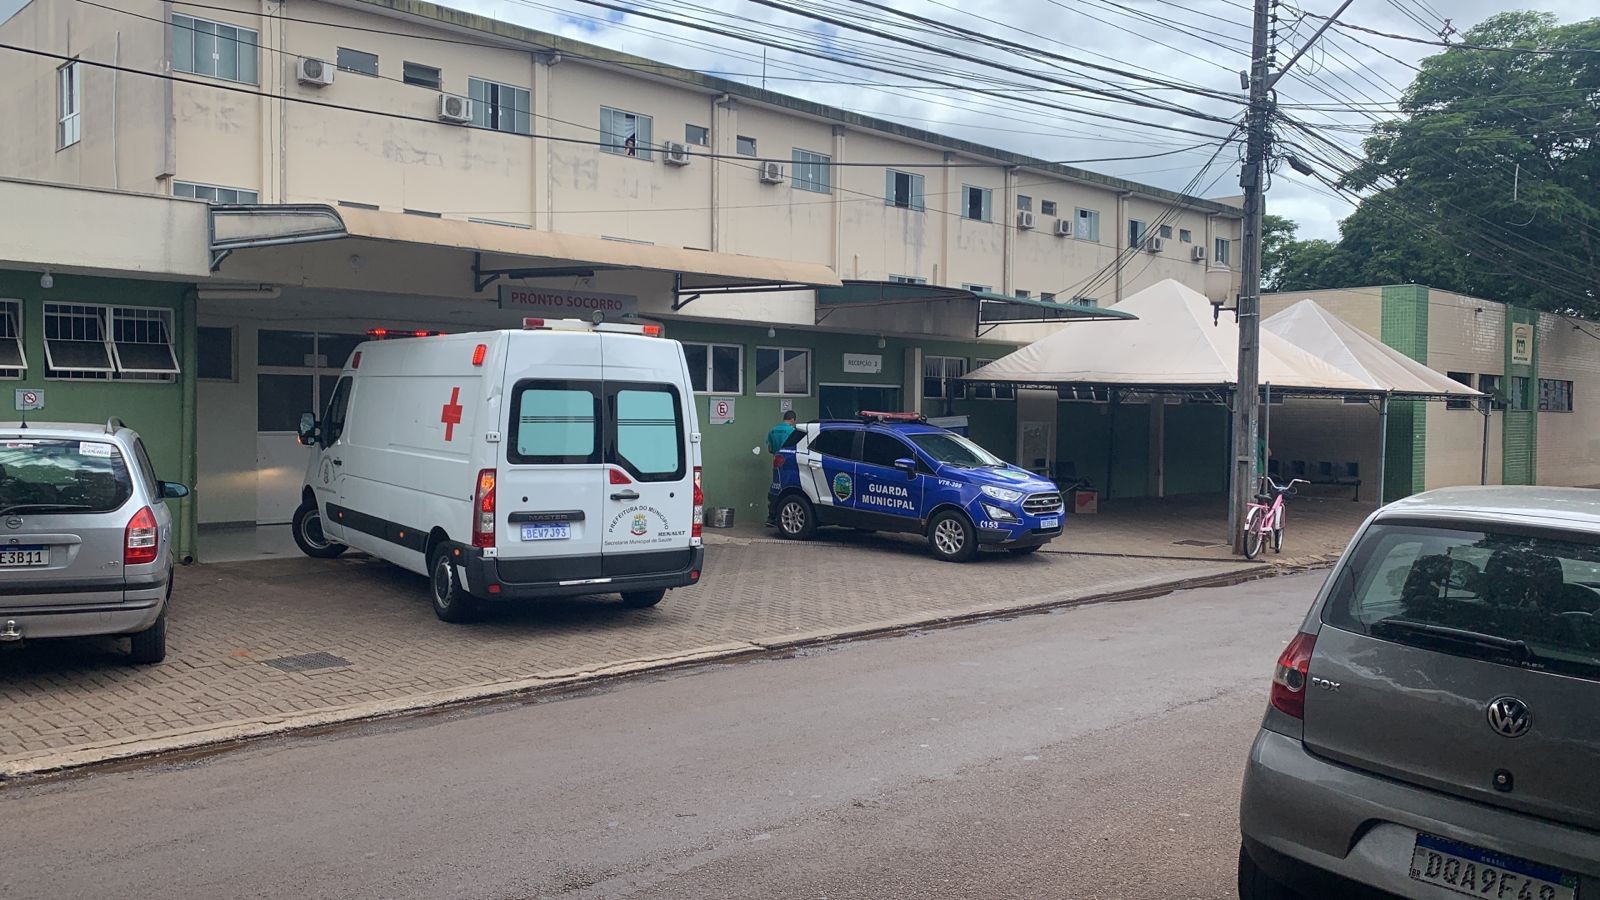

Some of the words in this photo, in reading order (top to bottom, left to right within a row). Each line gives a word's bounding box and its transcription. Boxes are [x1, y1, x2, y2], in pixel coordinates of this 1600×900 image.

[511, 291, 563, 306] PRONTO
[566, 295, 622, 311] SOCORRO
[868, 483, 908, 497] GUARDA
[862, 494, 915, 510] MUNICIPAL
[609, 505, 638, 533] PREFEITURA
[526, 528, 567, 539] BEW7J93
[1312, 677, 1340, 691] FOX
